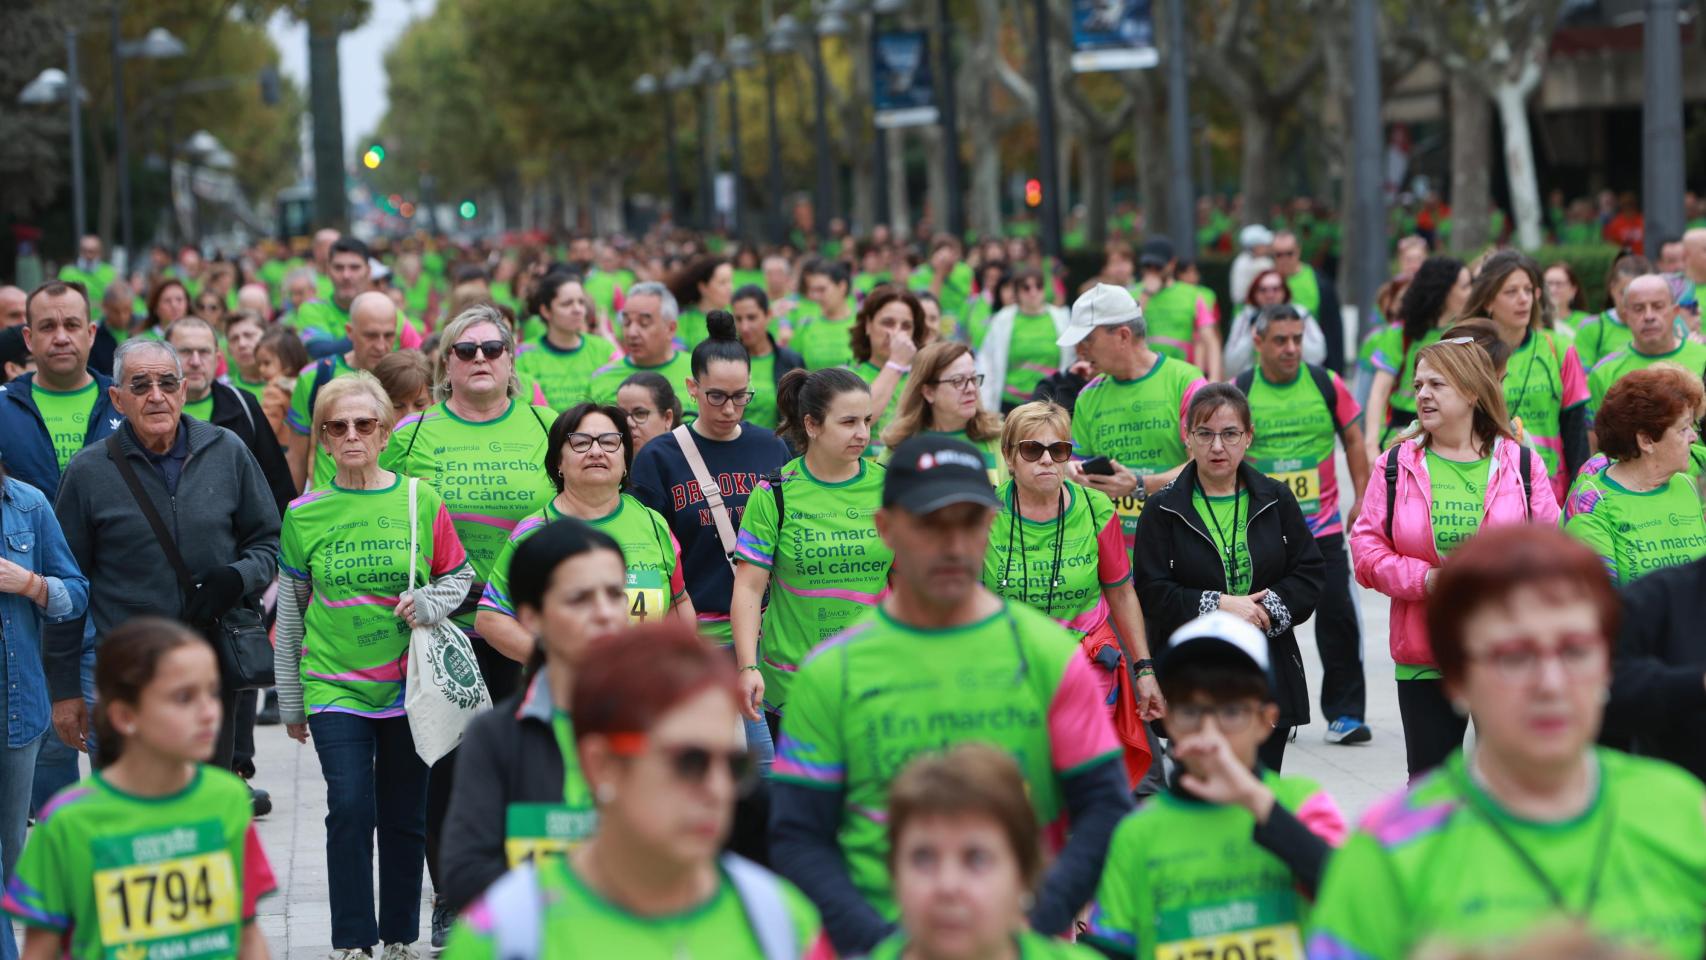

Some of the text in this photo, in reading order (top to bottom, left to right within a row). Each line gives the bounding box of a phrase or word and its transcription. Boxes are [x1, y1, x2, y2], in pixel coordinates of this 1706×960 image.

[1101, 424, 1115, 436] En
[1119, 417, 1171, 432] marcha
[1102, 435, 1142, 450] contra
[446, 459, 539, 472] En marcha
[435, 461, 444, 494] AMORA
[445, 474, 508, 486] contra
[443, 487, 536, 501] el cáncer
[1445, 500, 1484, 511] mar
[804, 528, 880, 542] En marc
[1437, 529, 1472, 542] cán
[335, 540, 356, 554] En
[793, 528, 806, 575] ZAMORA
[804, 543, 866, 558] contra
[1636, 540, 1658, 552] En
[323, 542, 334, 587] ZAMORA
[334, 553, 394, 570] contra
[807, 558, 887, 575] el cáncer
[1625, 540, 1640, 579] AMORA
[1640, 553, 1691, 569] contra
[334, 569, 410, 586] el cánce
[927, 706, 1041, 732] marcha
[110, 866, 214, 929] 1794
